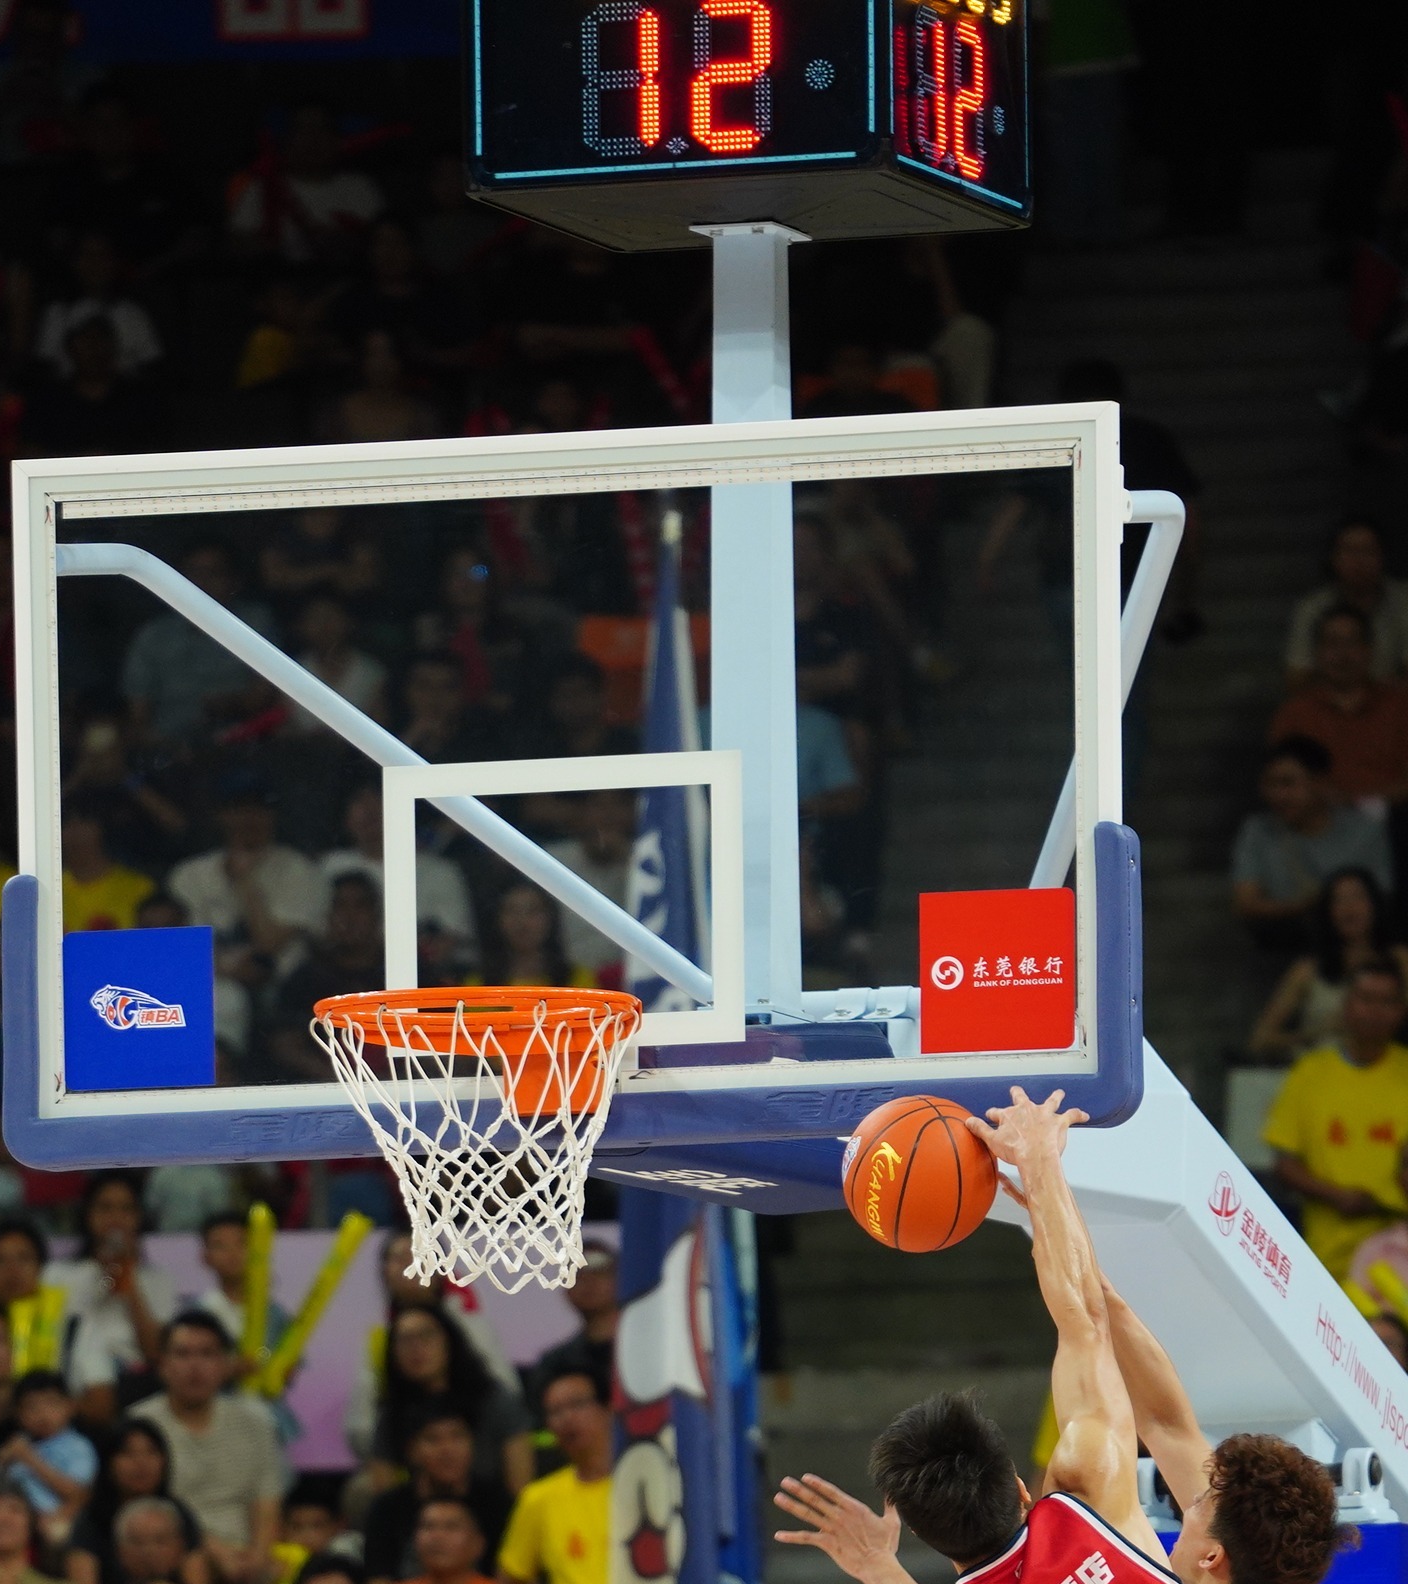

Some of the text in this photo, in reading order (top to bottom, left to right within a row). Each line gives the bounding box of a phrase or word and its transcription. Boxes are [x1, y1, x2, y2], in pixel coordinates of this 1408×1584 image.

[638, 0, 772, 152] 12
[972, 956, 1064, 978] 东莞银行
[973, 977, 1063, 988] BANK OF DONGGUAN
